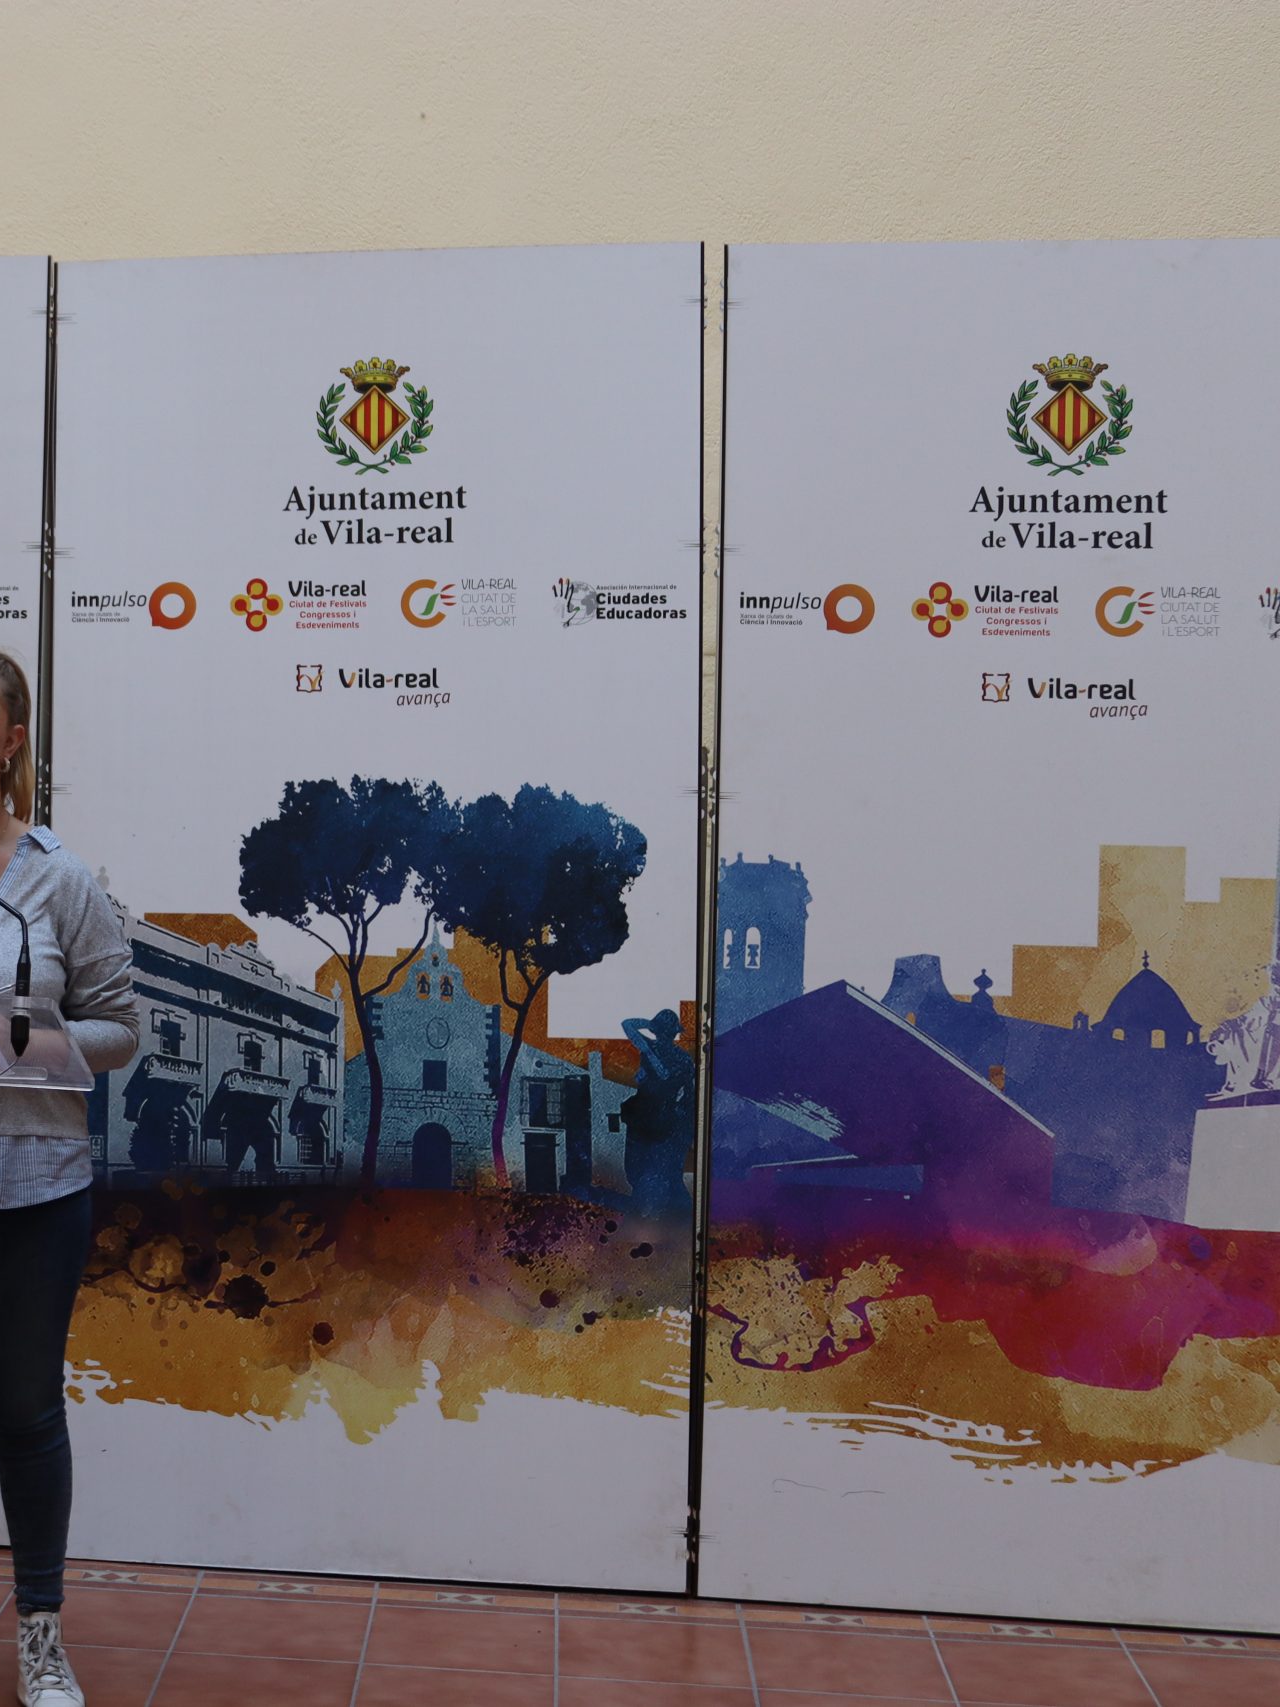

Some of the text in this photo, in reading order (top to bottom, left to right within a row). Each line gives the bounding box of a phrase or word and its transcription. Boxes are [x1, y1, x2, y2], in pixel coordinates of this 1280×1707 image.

[282, 485, 468, 520] Ajuntament
[969, 486, 1168, 521] Ajuntament
[294, 517, 454, 545] de Vila-real
[981, 521, 1154, 549] de Vila-real
[288, 580, 367, 597] Vila-real
[461, 578, 517, 590] VILA-REAL
[461, 593, 516, 603] CIUTAT DE
[596, 592, 667, 605] Ciudades
[974, 585, 1059, 603] Vila-real
[1161, 586, 1221, 599] VILA-REAL
[71, 590, 147, 611] innpulso
[289, 600, 367, 608] Ciutat de Festivals
[740, 591, 822, 613] innpulso
[1160, 602, 1220, 612] CIUTAT DE
[300, 611, 351, 620] Congressos
[462, 605, 516, 615] LA SALUT
[596, 607, 687, 619] Educadoras
[975, 606, 1059, 615] Ciutat de Festivals
[296, 621, 360, 629] Esdeveniments
[986, 617, 1041, 626] Congressos
[1161, 615, 1220, 625] LA SALUT
[982, 628, 1051, 637] Esdeveniments
[338, 667, 439, 689] Vila-real
[1028, 677, 1136, 700] Vila-real
[396, 692, 451, 708] avança
[1089, 704, 1148, 720] avança
